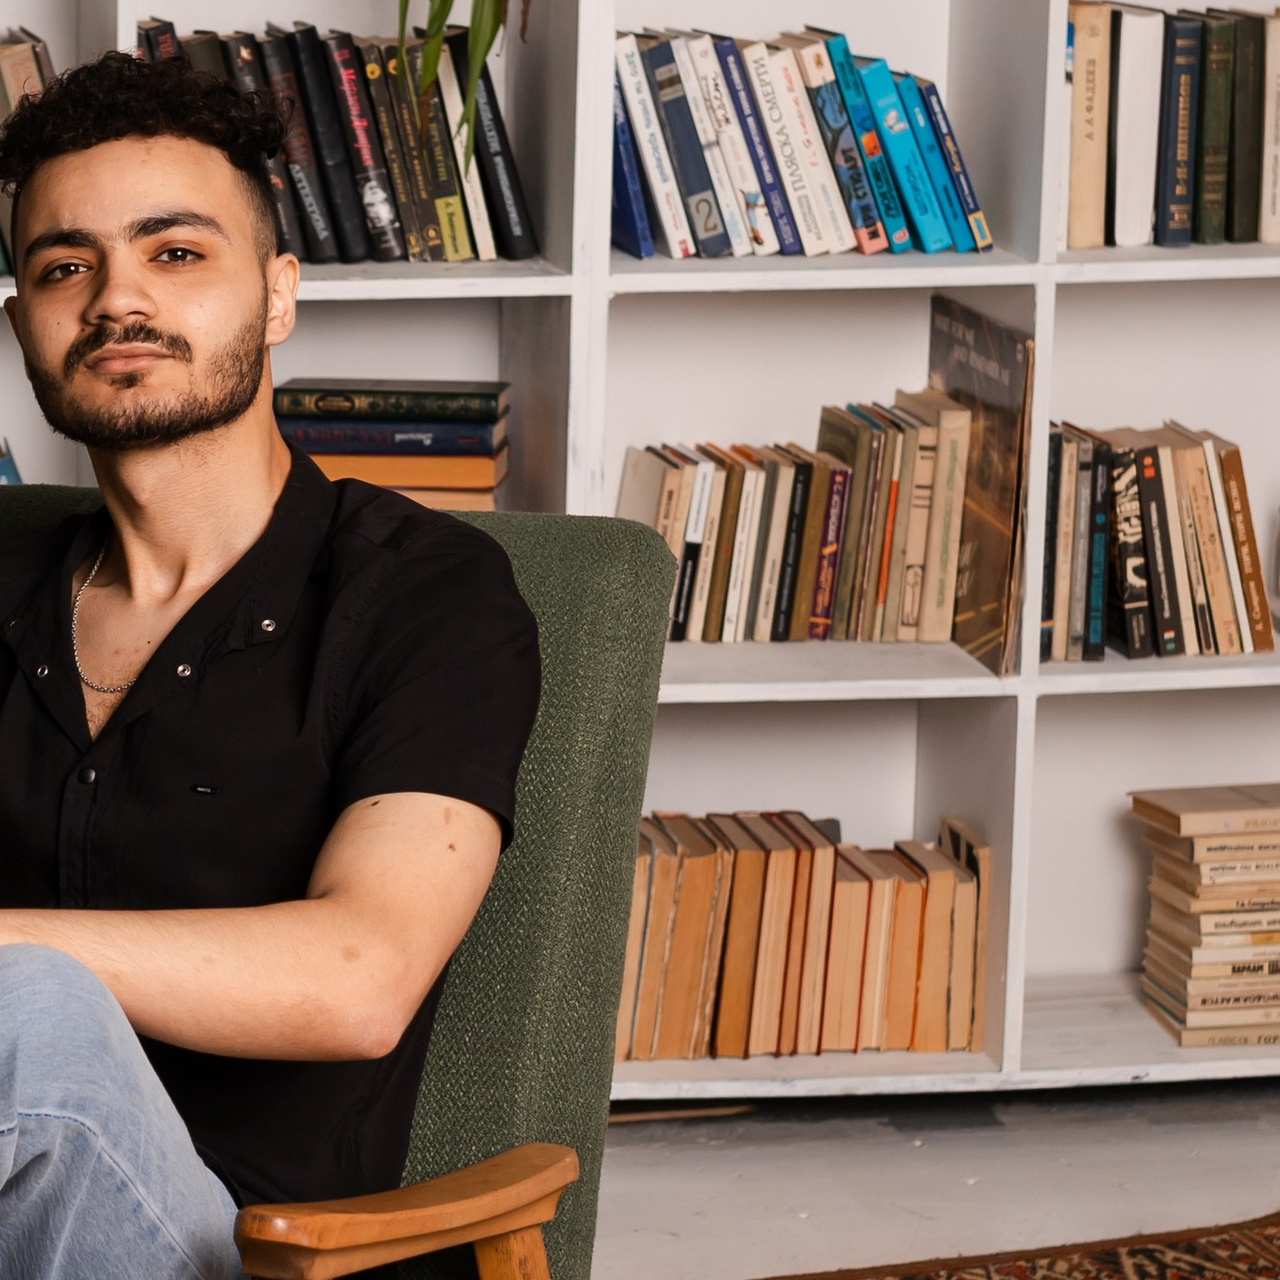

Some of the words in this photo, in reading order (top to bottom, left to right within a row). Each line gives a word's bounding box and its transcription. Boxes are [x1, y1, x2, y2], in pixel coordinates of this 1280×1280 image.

[751, 54, 785, 125] СМЕРТИ
[1084, 58, 1096, 114] ФАДЕЕВ
[773, 123, 806, 193] ПЛЯСКА
[289, 163, 328, 242] ДЕТЕКТИВА
[691, 199, 718, 235] 2
[1231, 964, 1264, 975] ВАРЛАМ
